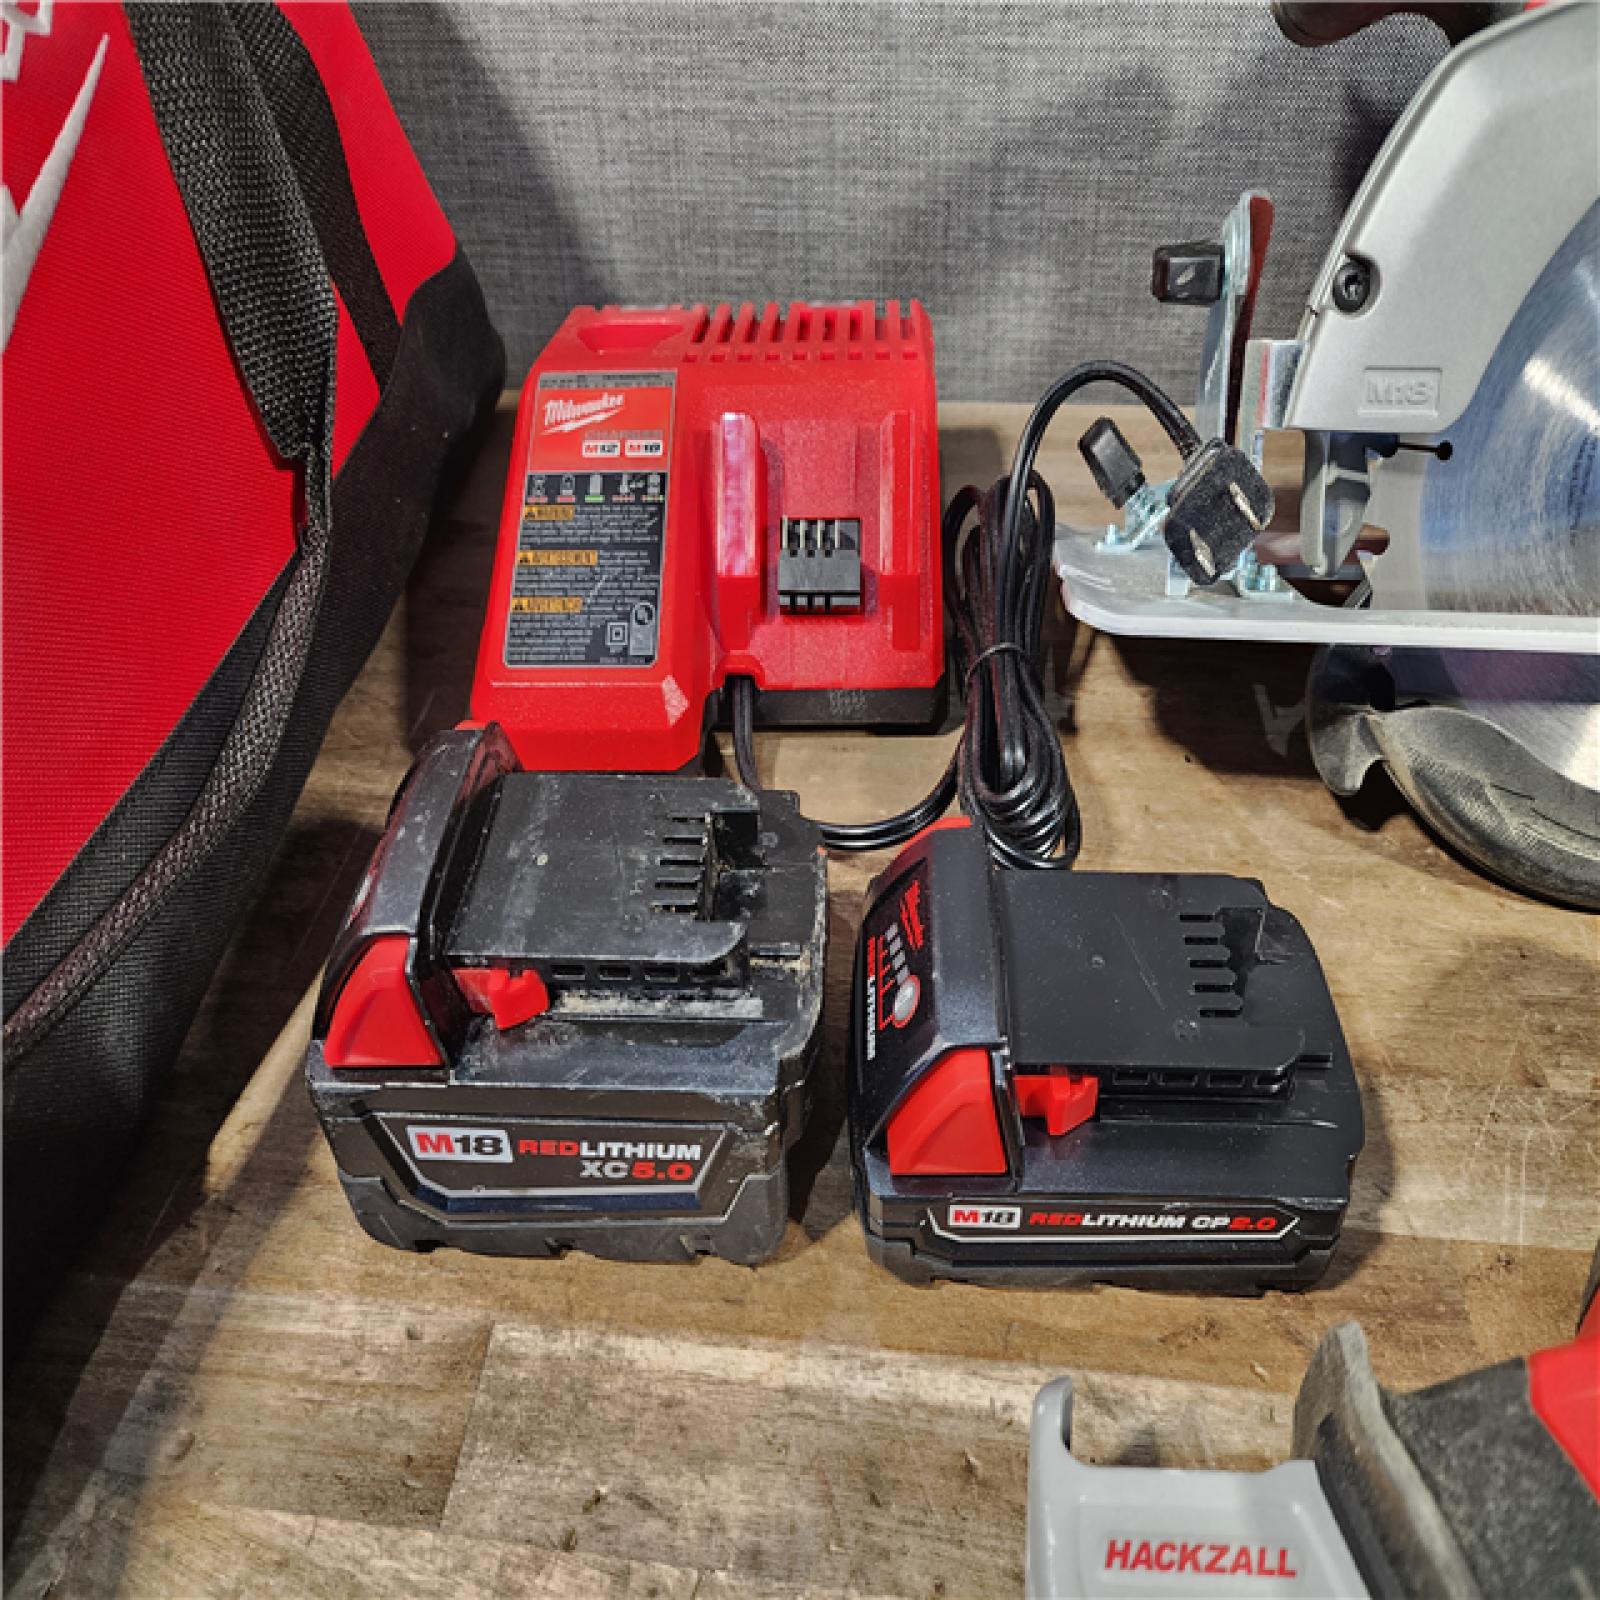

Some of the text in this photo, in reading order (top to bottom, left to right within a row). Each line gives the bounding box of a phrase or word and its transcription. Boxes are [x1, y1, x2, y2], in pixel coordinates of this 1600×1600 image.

[415, 1132, 701, 1160] M18 REDLITHIUM
[580, 1160, 693, 1180] XC5.0
[954, 1210, 1016, 1224] M18
[1029, 1212, 1185, 1229] REDLITHIUM
[1105, 1539, 1297, 1577] HACKZALL
